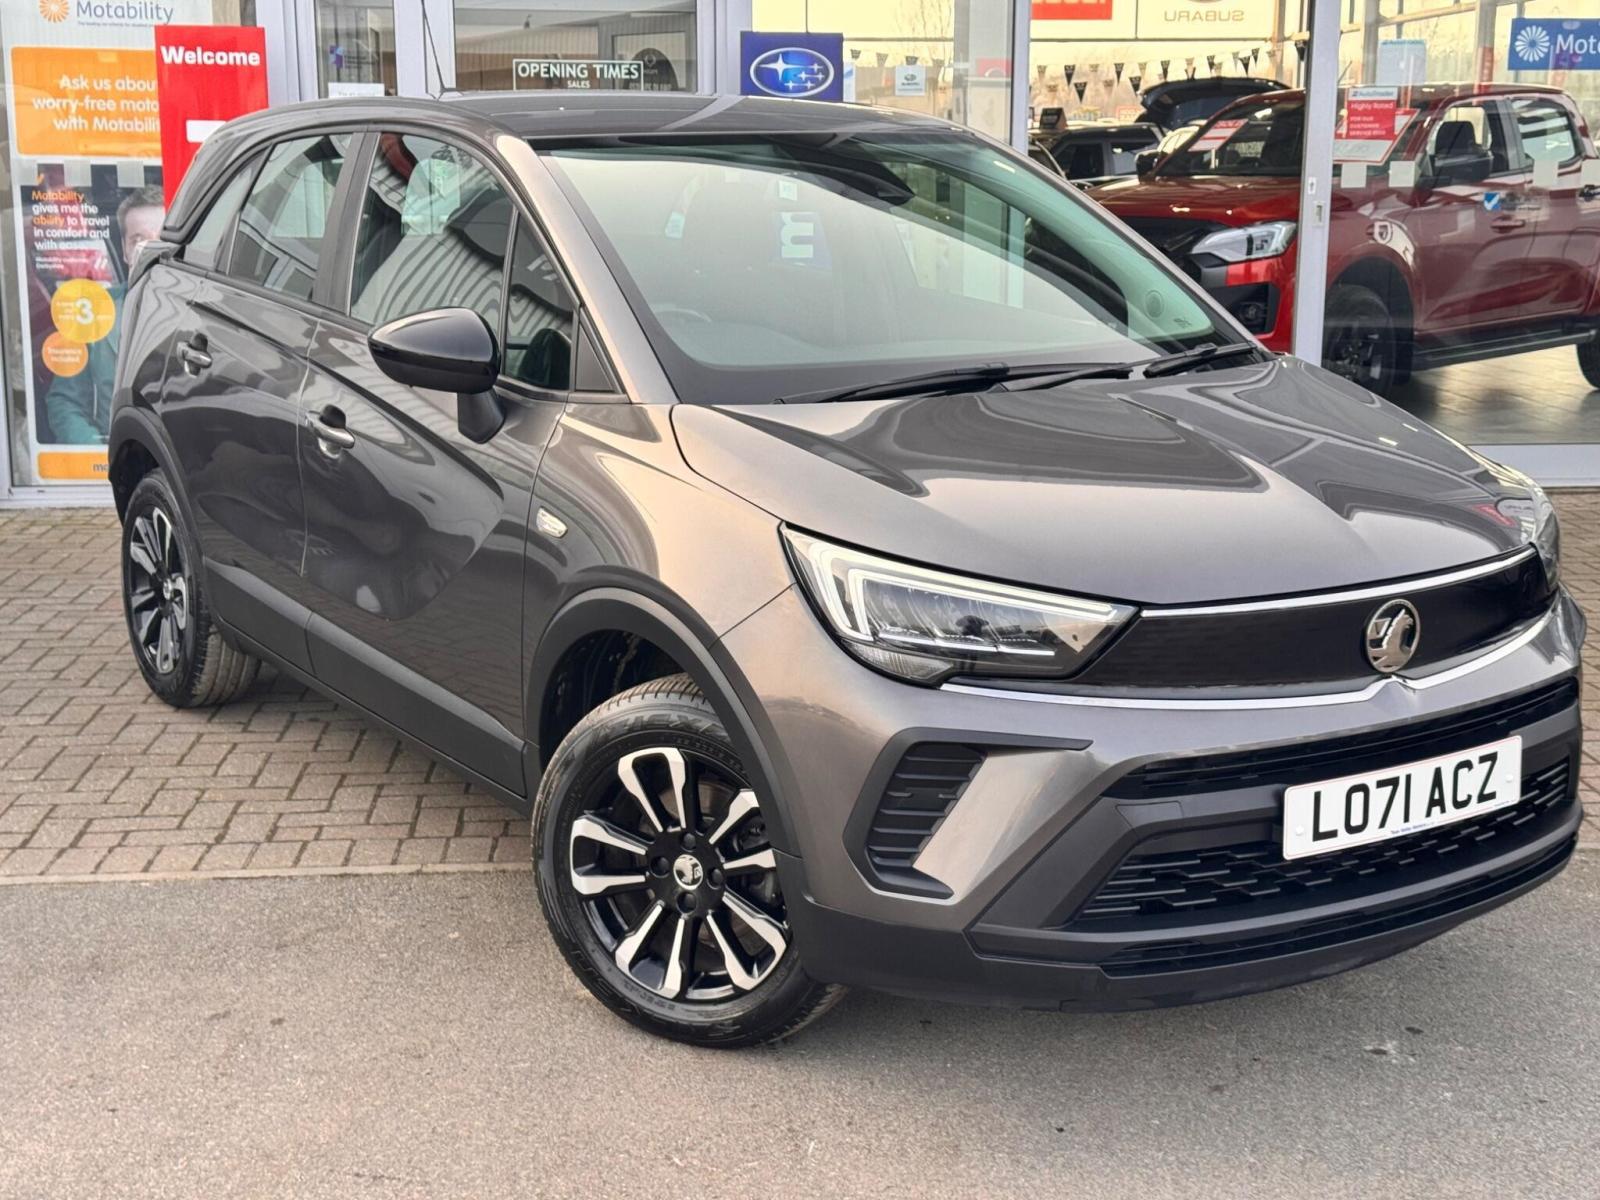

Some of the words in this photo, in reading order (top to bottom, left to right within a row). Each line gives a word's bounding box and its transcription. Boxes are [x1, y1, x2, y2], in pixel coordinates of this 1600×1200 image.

[77, 0, 173, 25] Motability
[160, 45, 260, 66] Welcome
[517, 63, 589, 79] OPENING
[593, 64, 640, 80] TIMES
[59, 75, 88, 90] Ask
[93, 79, 111, 90] us
[566, 80, 591, 90] SALES
[33, 95, 116, 113] worry-free
[54, 115, 88, 131] with
[31, 191, 84, 203] Motability
[32, 204, 59, 215] gives
[60, 204, 79, 213] me
[81, 203, 98, 214] the
[32, 215, 64, 227] ability
[66, 215, 78, 225] to
[80, 215, 110, 226] travel
[33, 227, 44, 237] in
[45, 227, 88, 237] comfort
[89, 227, 110, 238] and
[34, 239, 57, 250] with
[76, 297, 95, 325] 3
[1425, 751, 1498, 818] ACZ
